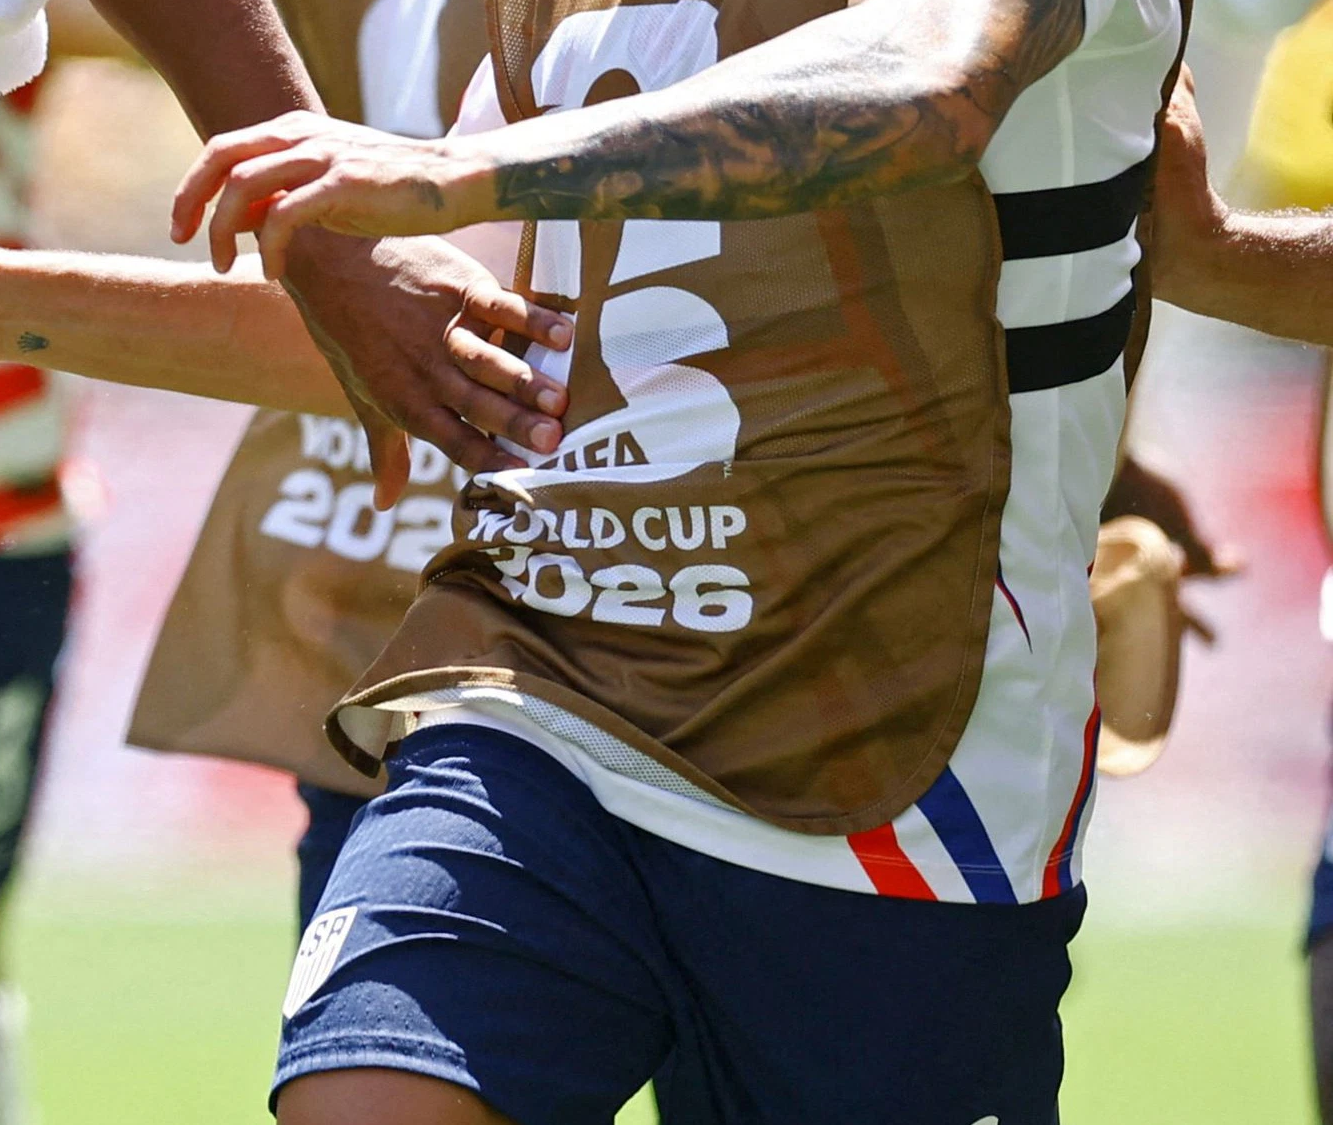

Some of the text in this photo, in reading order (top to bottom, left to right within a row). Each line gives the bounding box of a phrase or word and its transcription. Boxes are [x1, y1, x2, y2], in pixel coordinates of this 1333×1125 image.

[258, 467, 455, 573] 202
[631, 504, 747, 552] CUP
[300, 914, 350, 958] SA
